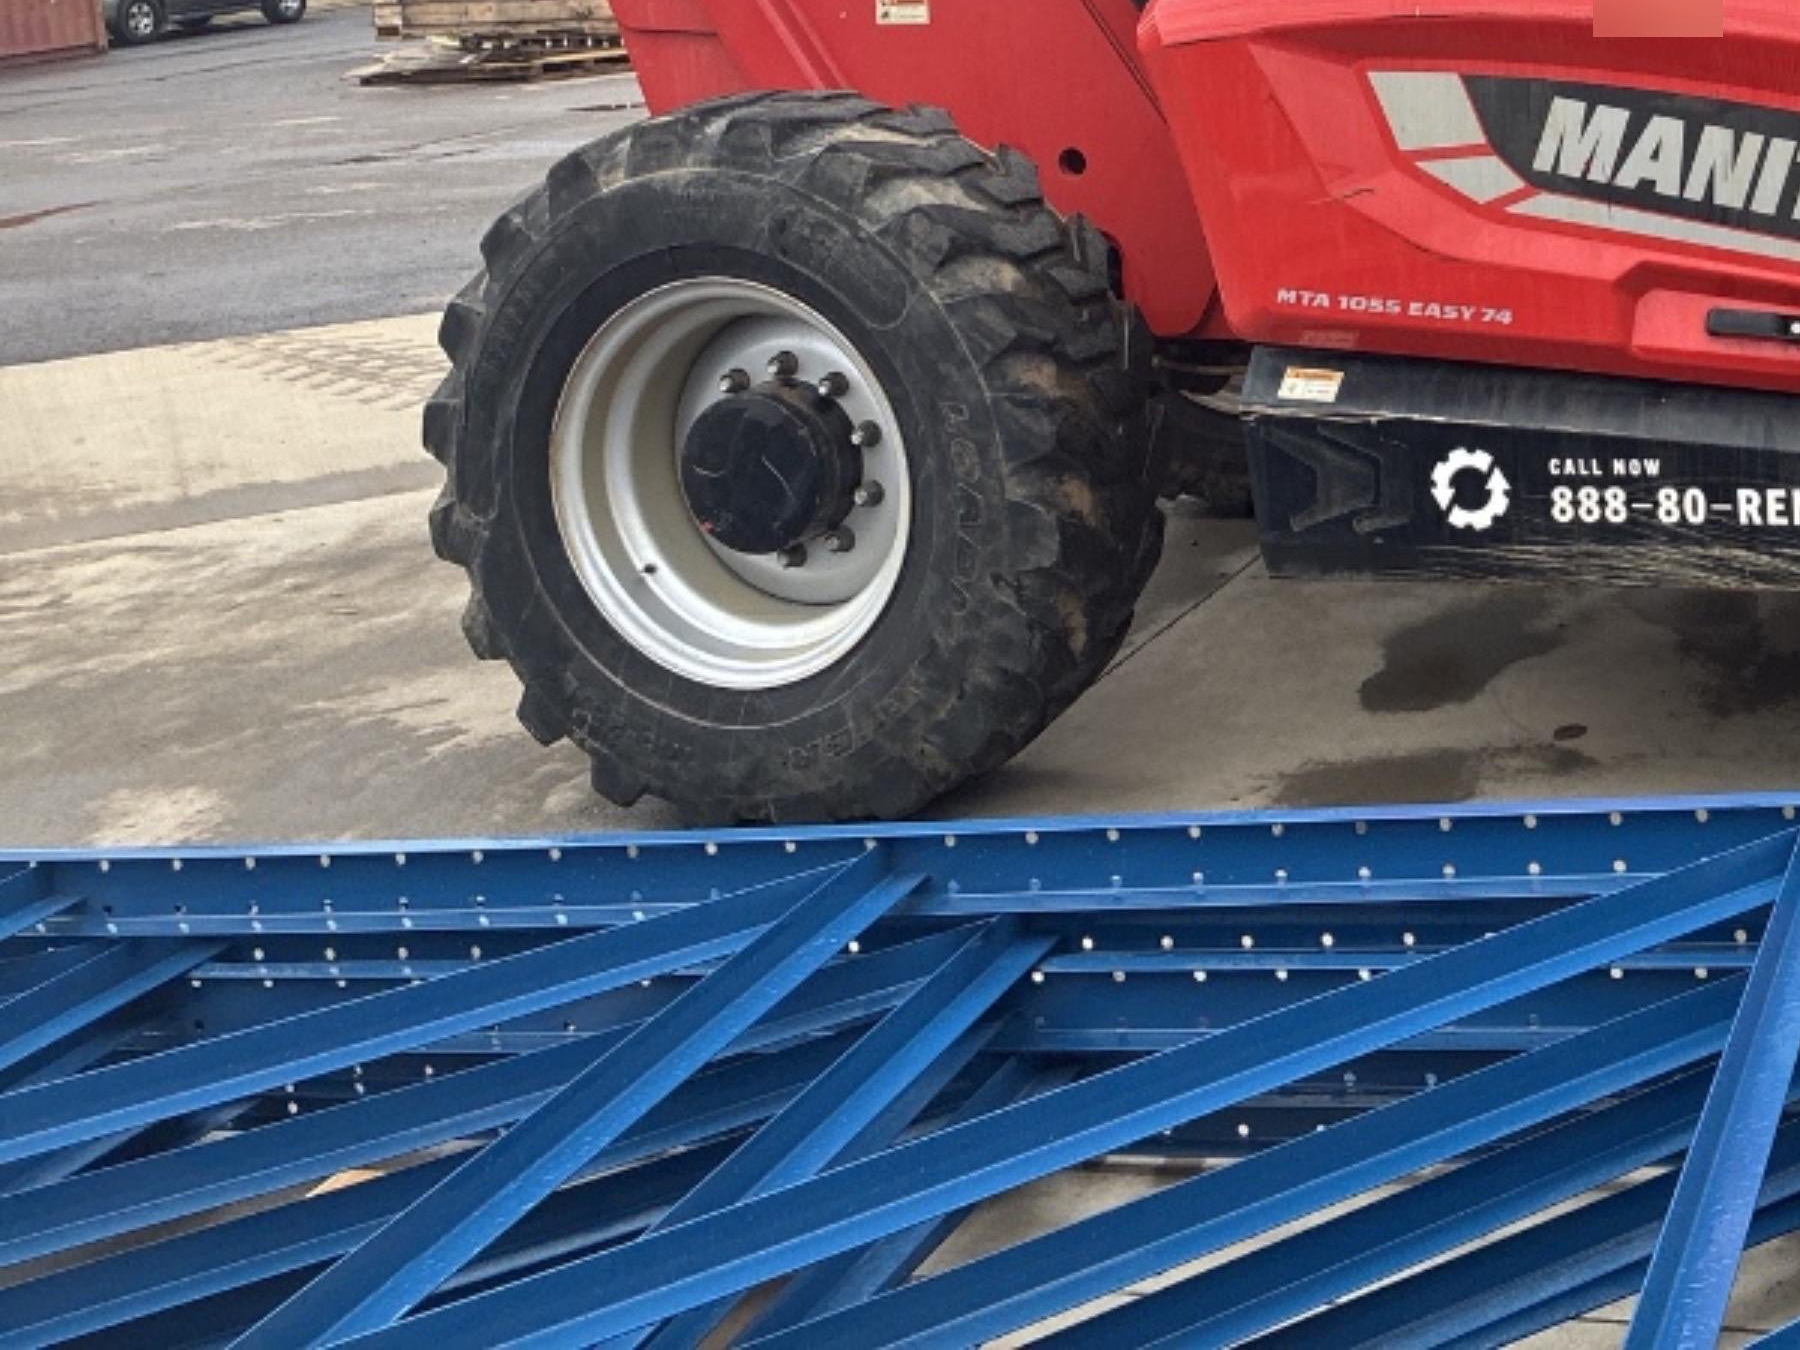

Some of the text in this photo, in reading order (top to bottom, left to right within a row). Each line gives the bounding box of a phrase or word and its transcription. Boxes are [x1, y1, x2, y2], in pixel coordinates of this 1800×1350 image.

[1276, 288, 1513, 326] MTA 1055 EASY 74
[1548, 457, 1661, 477] CALL NOW
